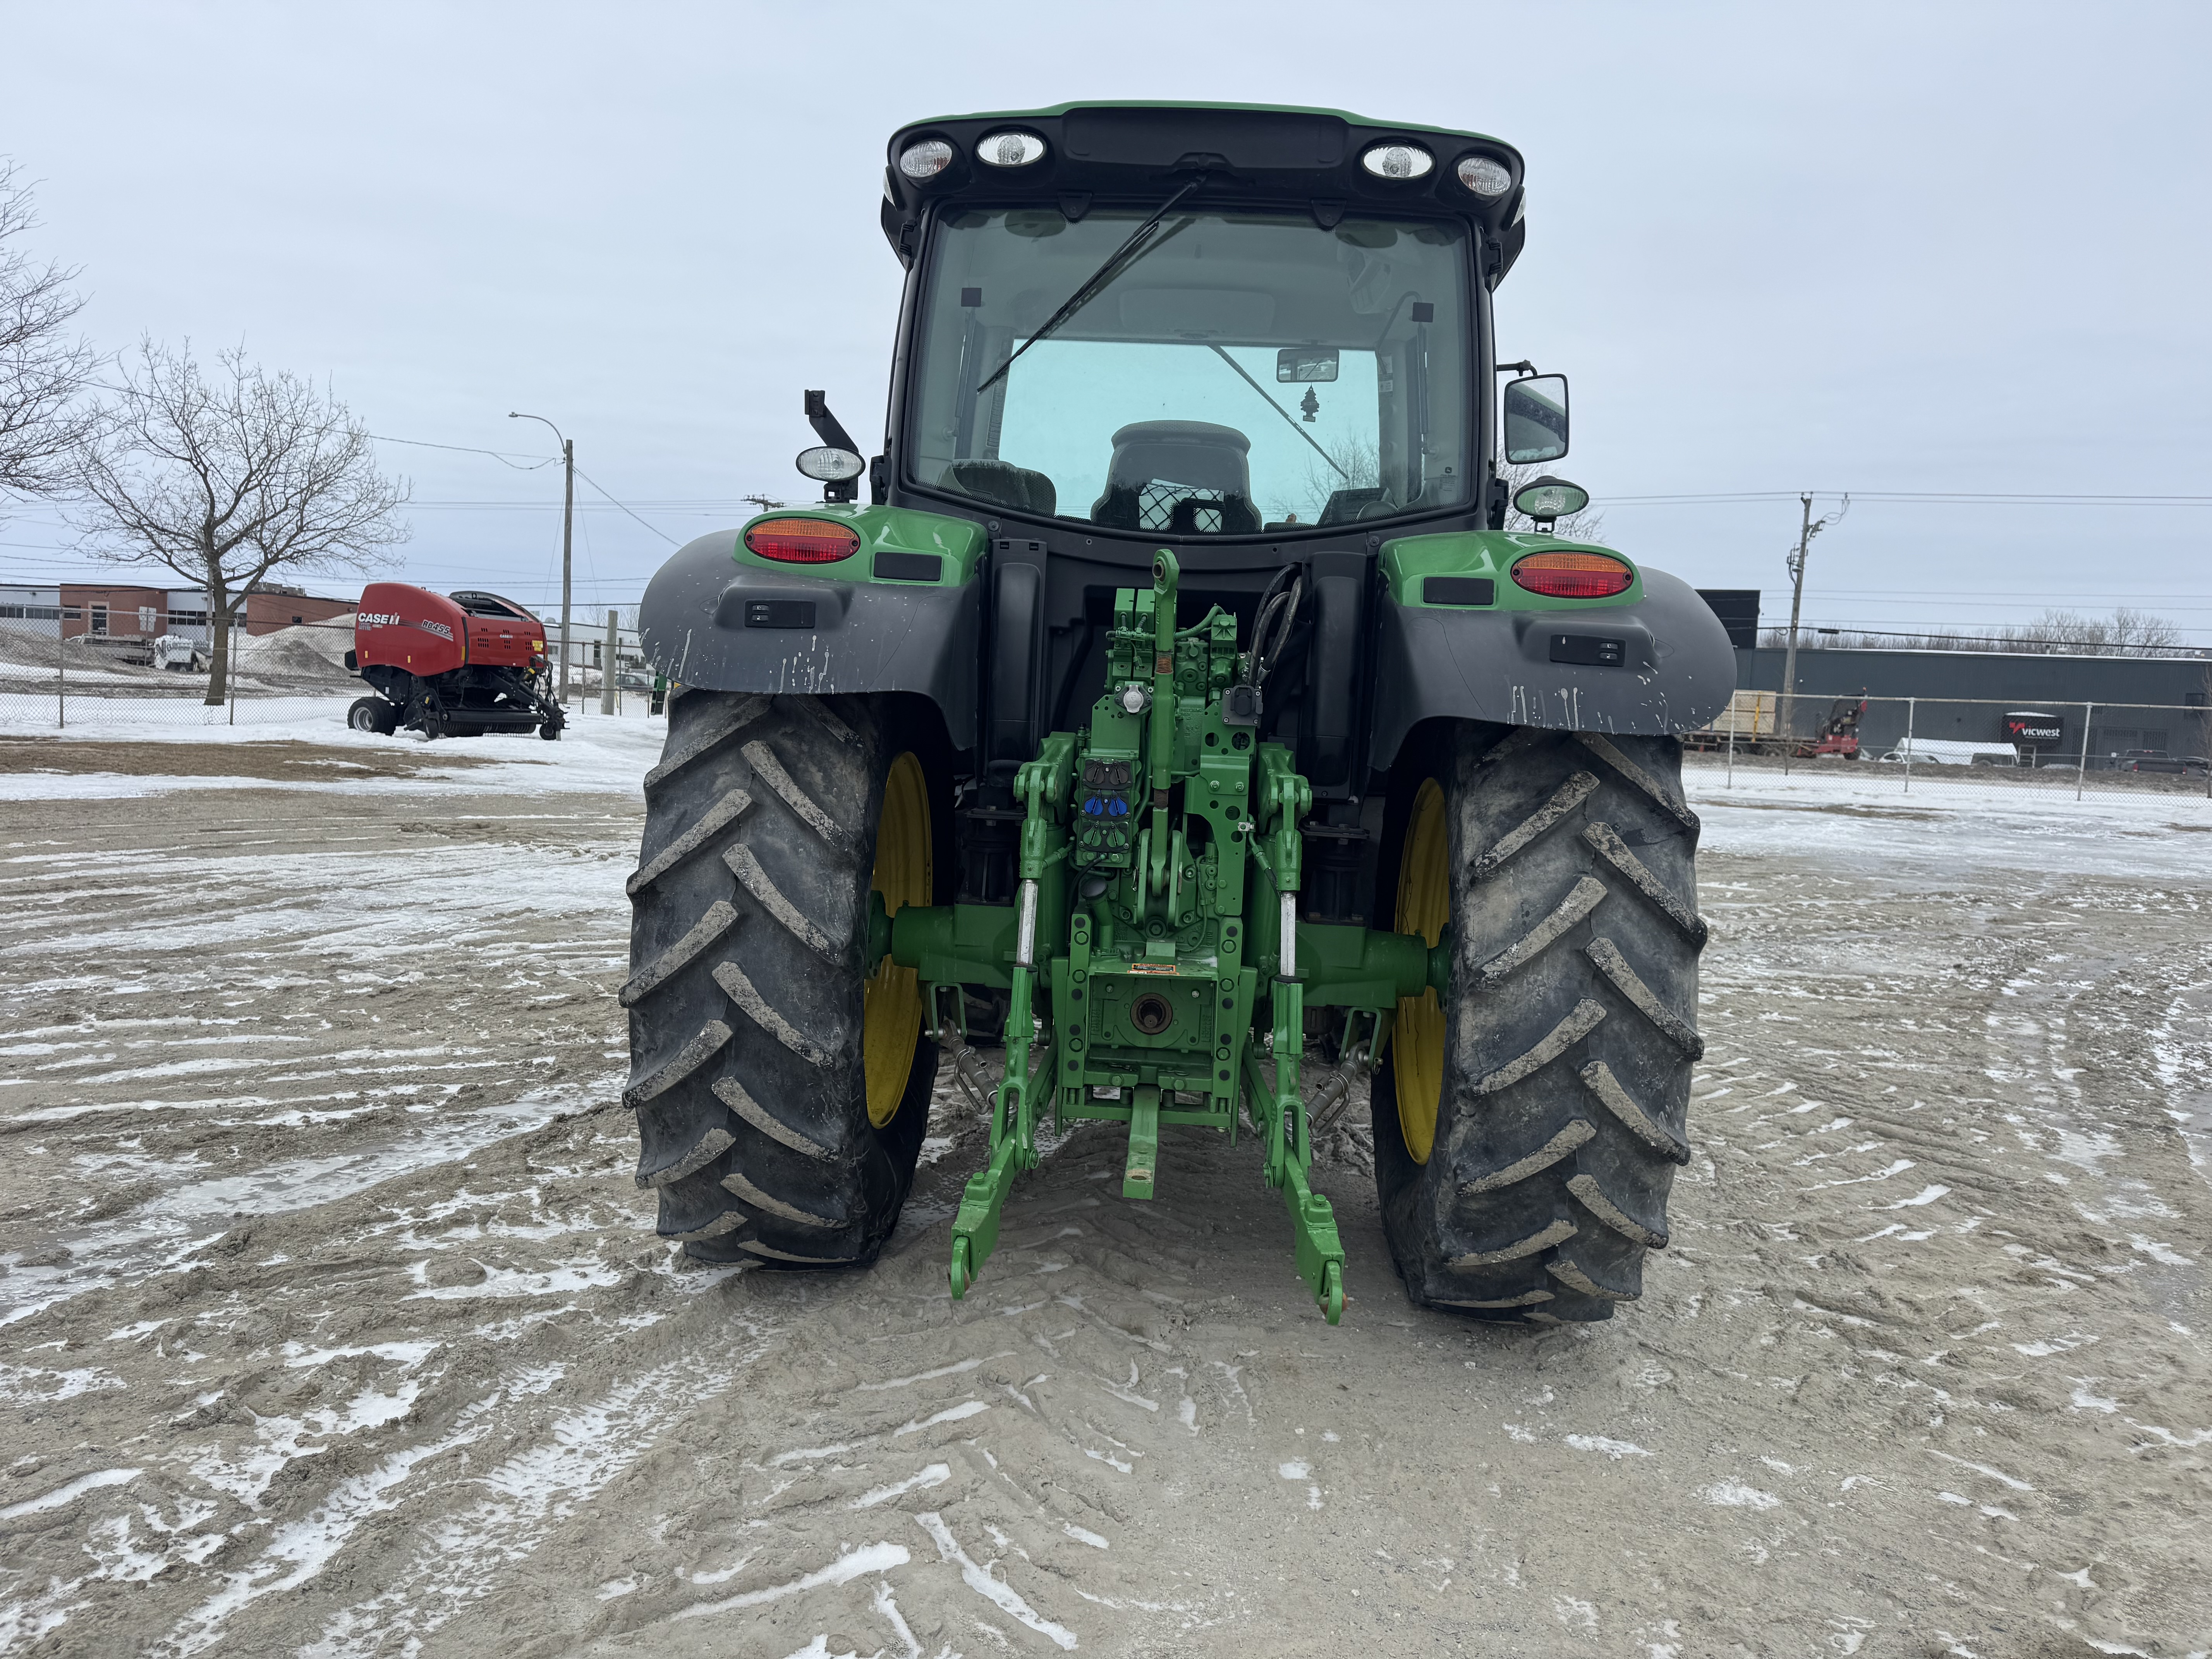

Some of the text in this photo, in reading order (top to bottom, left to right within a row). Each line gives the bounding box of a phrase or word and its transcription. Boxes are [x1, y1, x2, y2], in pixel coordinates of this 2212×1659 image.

[358, 612, 389, 624] CASE
[422, 619, 451, 634] RB455
[2022, 725, 2060, 737] vicwest
